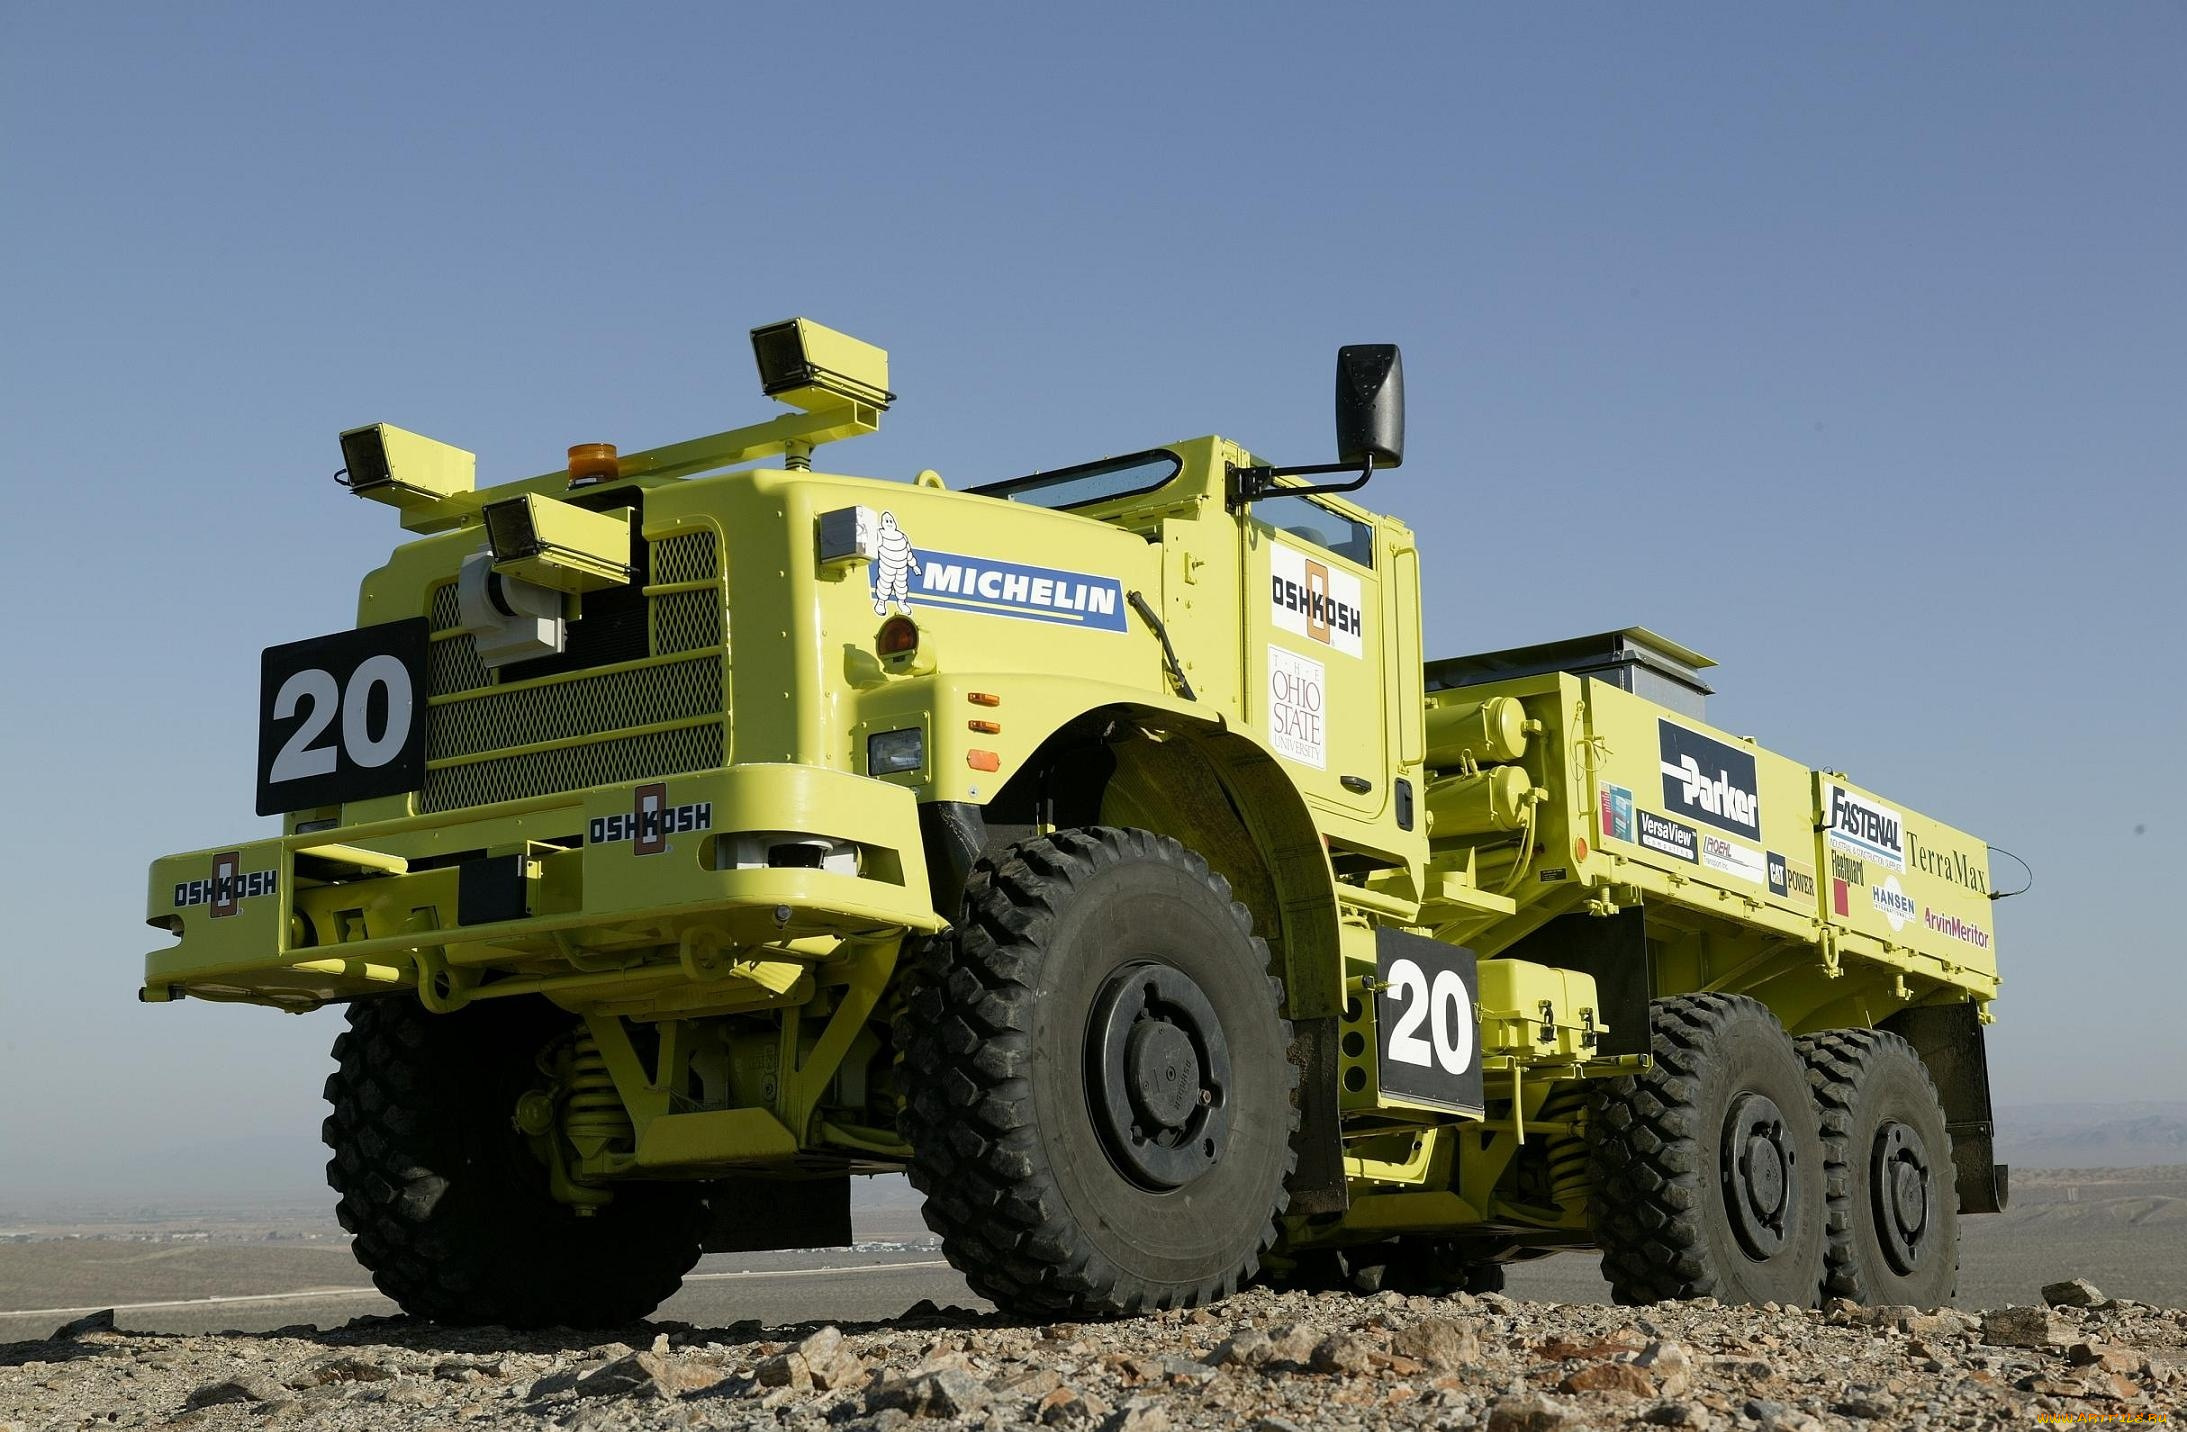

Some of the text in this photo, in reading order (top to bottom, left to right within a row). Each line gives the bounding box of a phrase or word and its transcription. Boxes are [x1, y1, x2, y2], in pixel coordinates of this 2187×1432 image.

[922, 562, 1116, 615] MICHELIN
[1272, 575, 1361, 638] OSHKOSH
[1273, 670, 1321, 712] OHIO
[269, 654, 413, 784] 20
[1274, 702, 1321, 746] STATE
[1274, 733, 1321, 761] UNIVERSITY
[1661, 753, 1757, 828] Parker
[589, 802, 712, 844] OSHKOSH
[1831, 785, 1902, 853] FASTENAL
[1769, 861, 1815, 897] CAT POWER
[1906, 830, 1987, 895] TerraMax
[174, 869, 278, 907] OSHKOSH
[1872, 885, 1915, 915] HANSEN
[1924, 906, 1989, 949] ArvinMeritor
[1387, 958, 1474, 1075] 20
